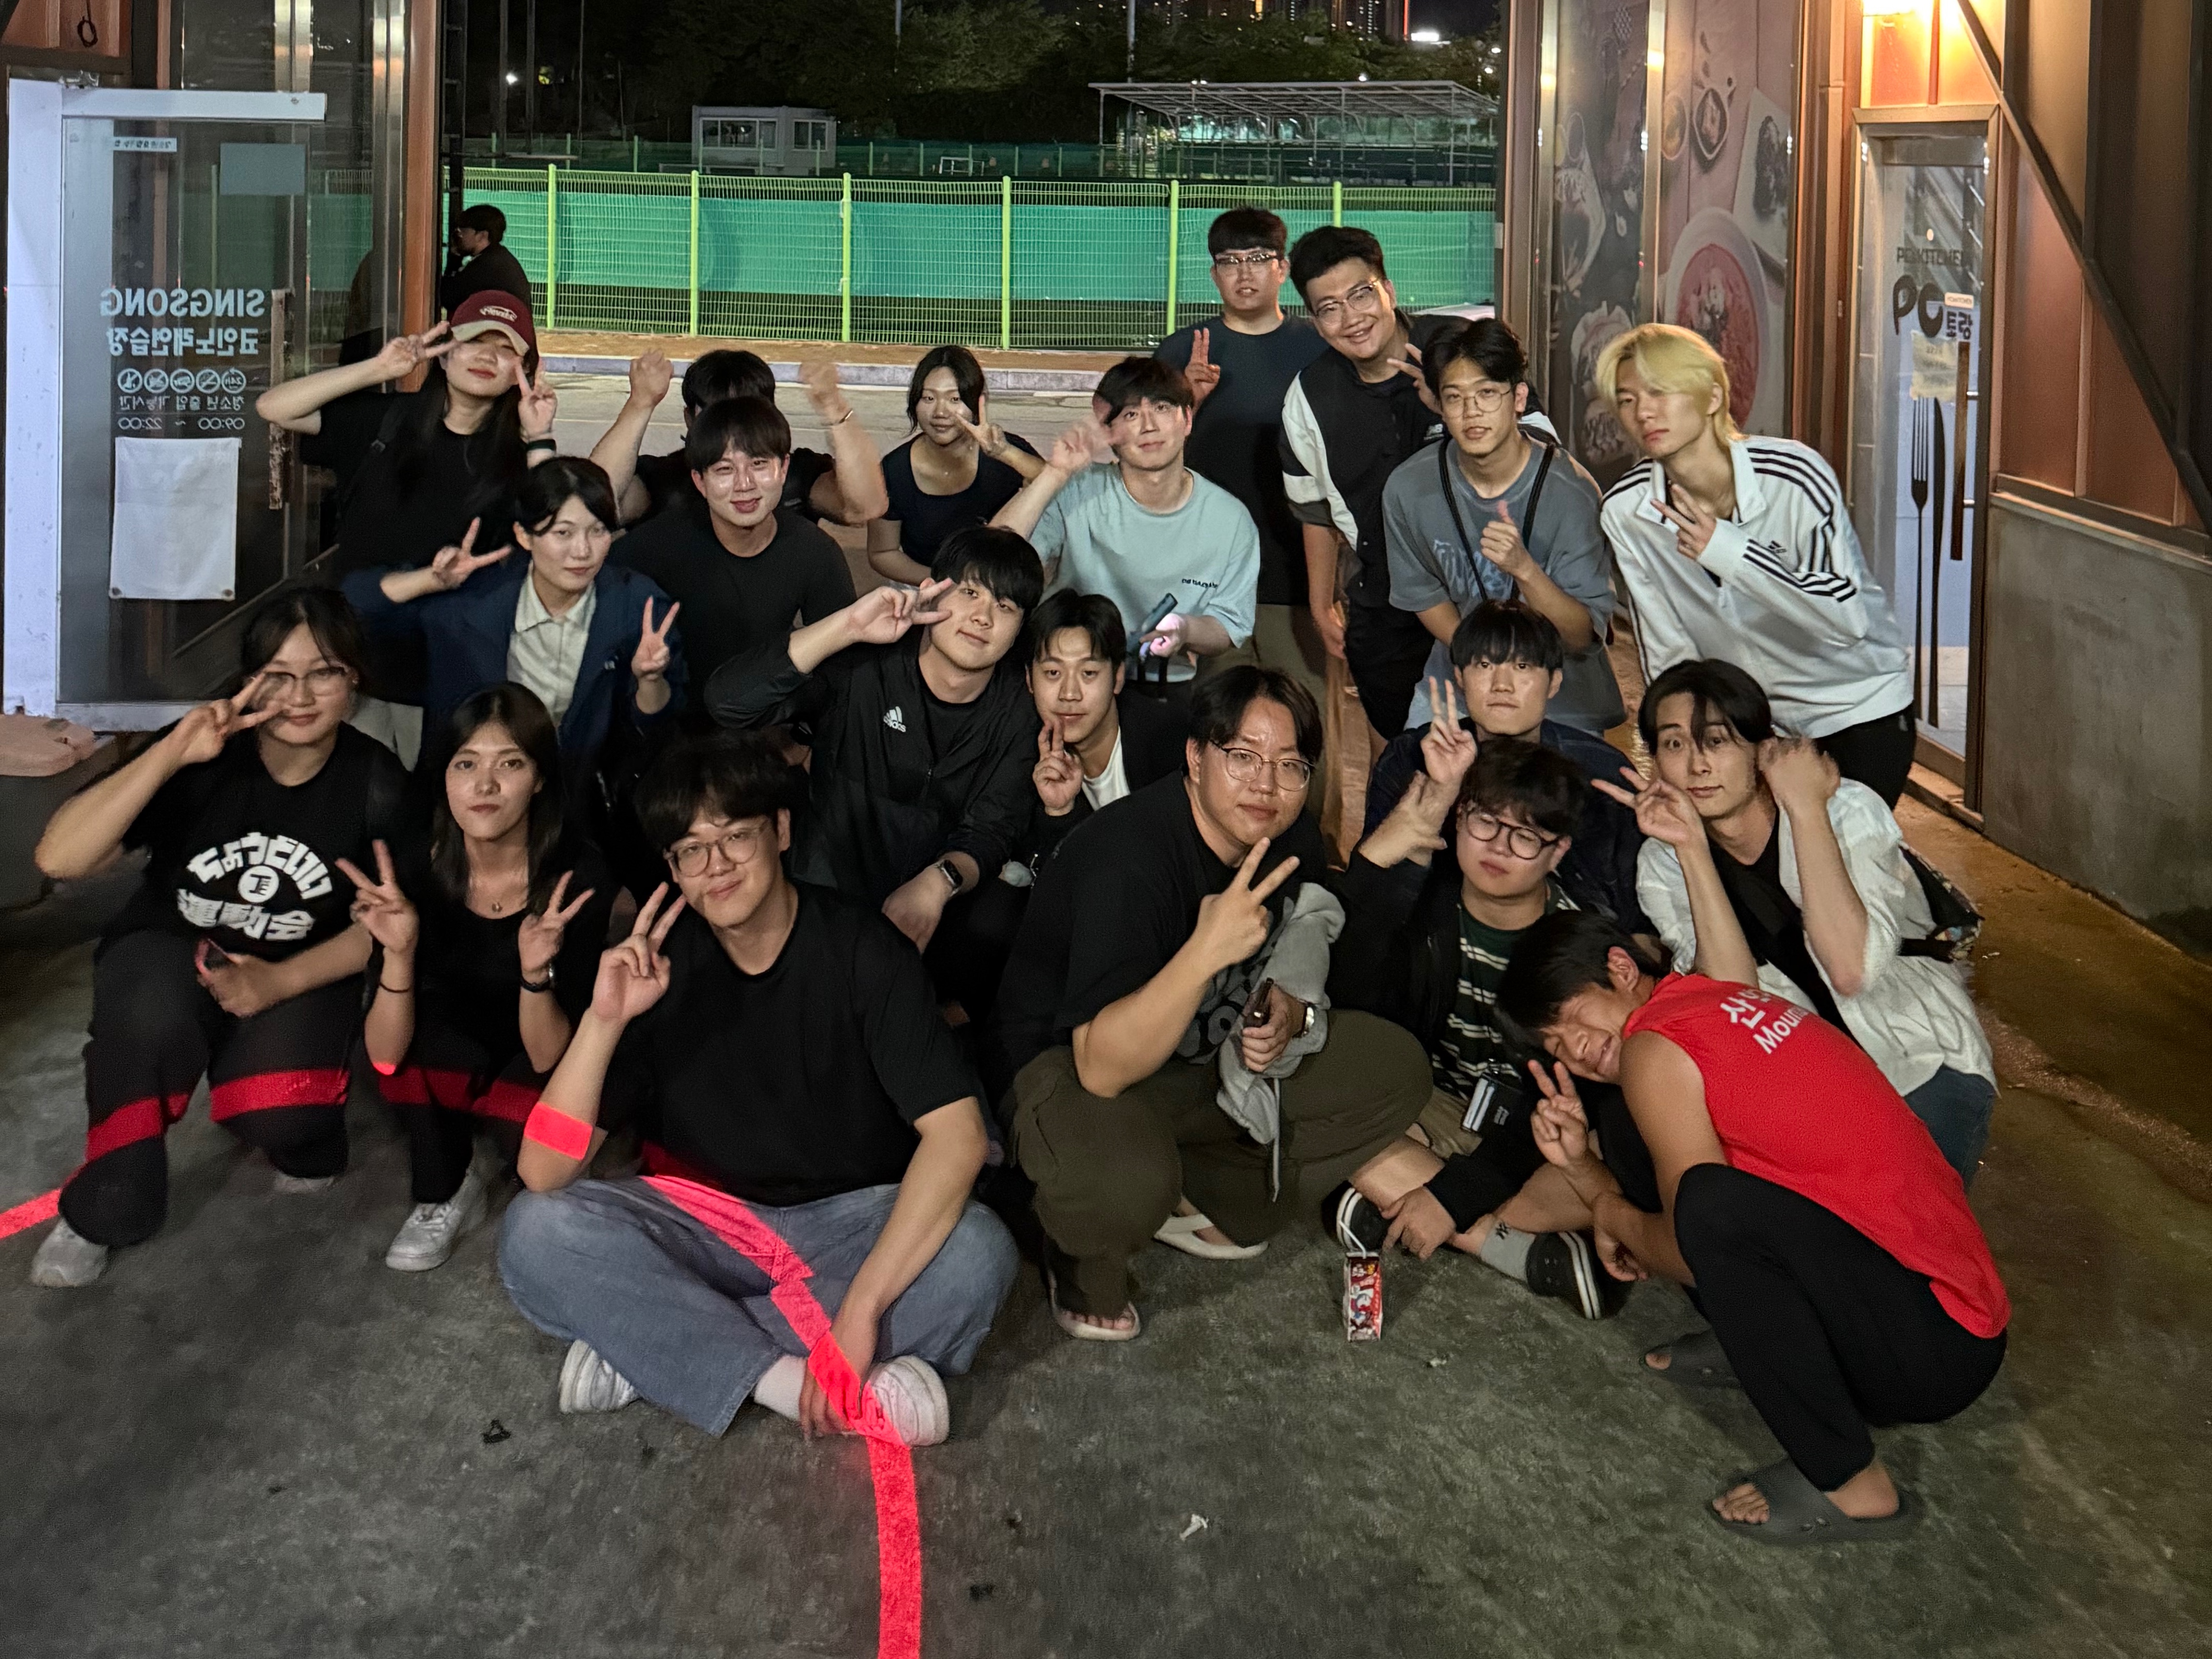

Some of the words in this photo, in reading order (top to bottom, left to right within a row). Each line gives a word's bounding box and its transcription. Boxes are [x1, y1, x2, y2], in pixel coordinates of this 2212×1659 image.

[186, 831, 333, 899] ちょうどいい
